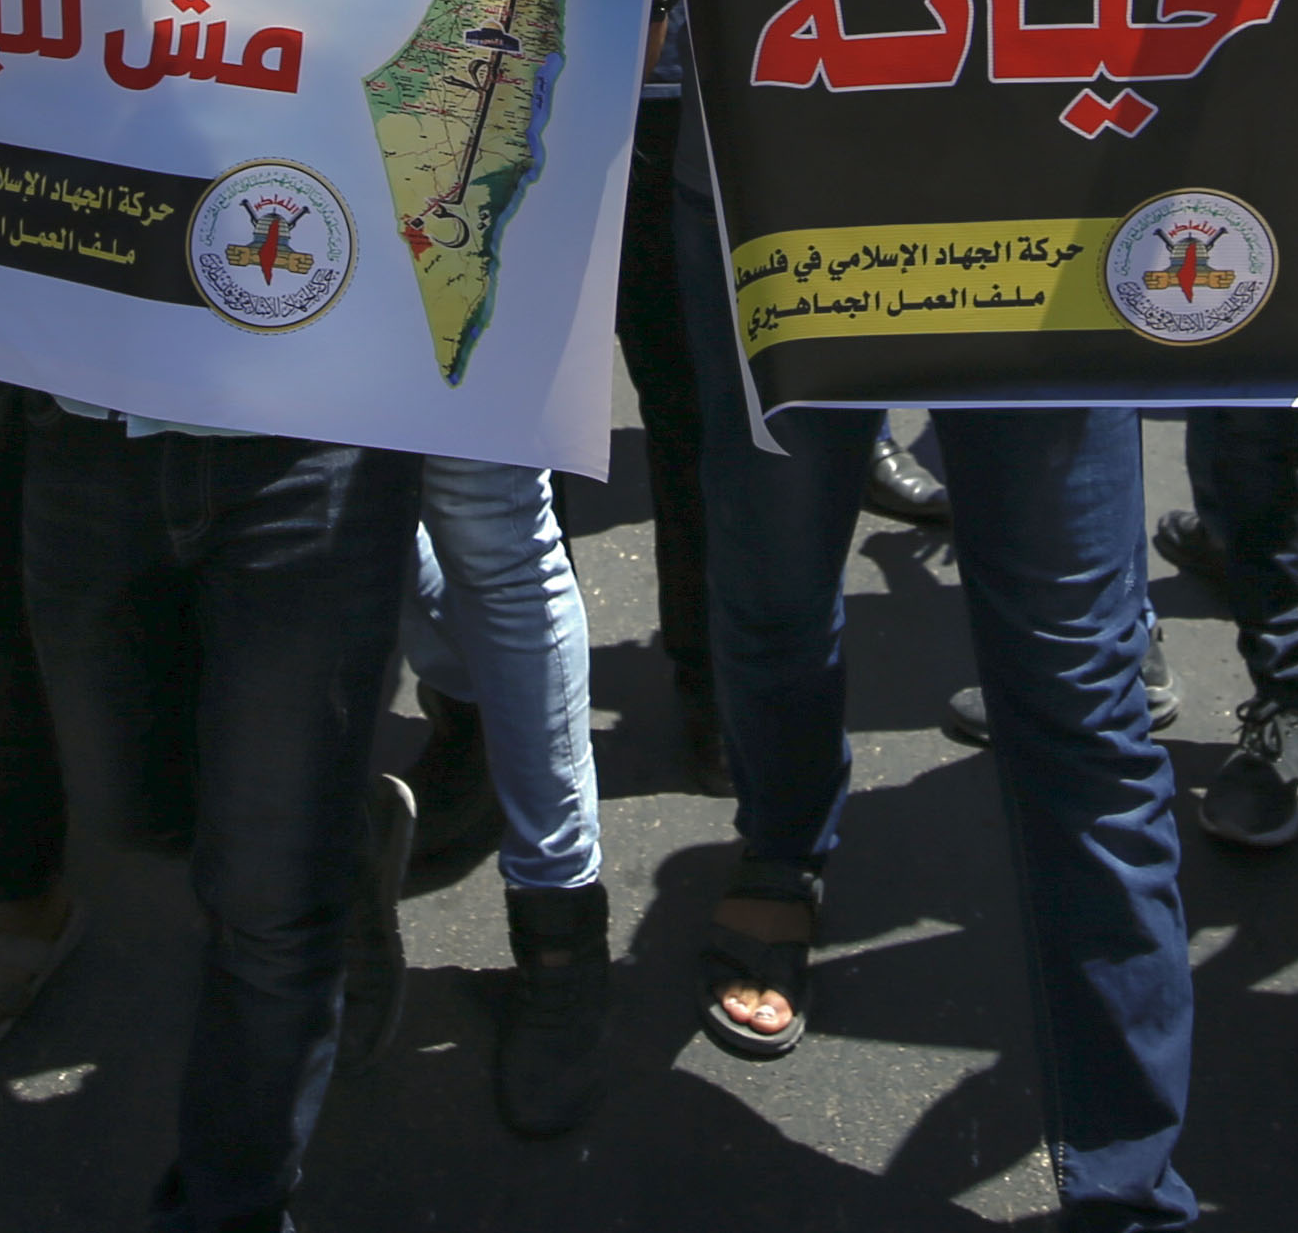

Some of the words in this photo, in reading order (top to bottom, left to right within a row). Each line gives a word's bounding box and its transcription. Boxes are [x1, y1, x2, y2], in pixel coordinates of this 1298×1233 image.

[50, 178, 112, 214] الجهاد
[117, 185, 175, 226] حركة
[9, 219, 74, 253] العمل
[78, 232, 136, 265] ملف
[1018, 236, 1084, 268] حركة
[794, 245, 822, 283] في
[828, 242, 928, 281] الإسلامي
[935, 240, 1011, 271] الجهاد
[887, 287, 967, 317] العمل
[973, 283, 1045, 308] ملف
[747, 291, 880, 341] الجماهيري
